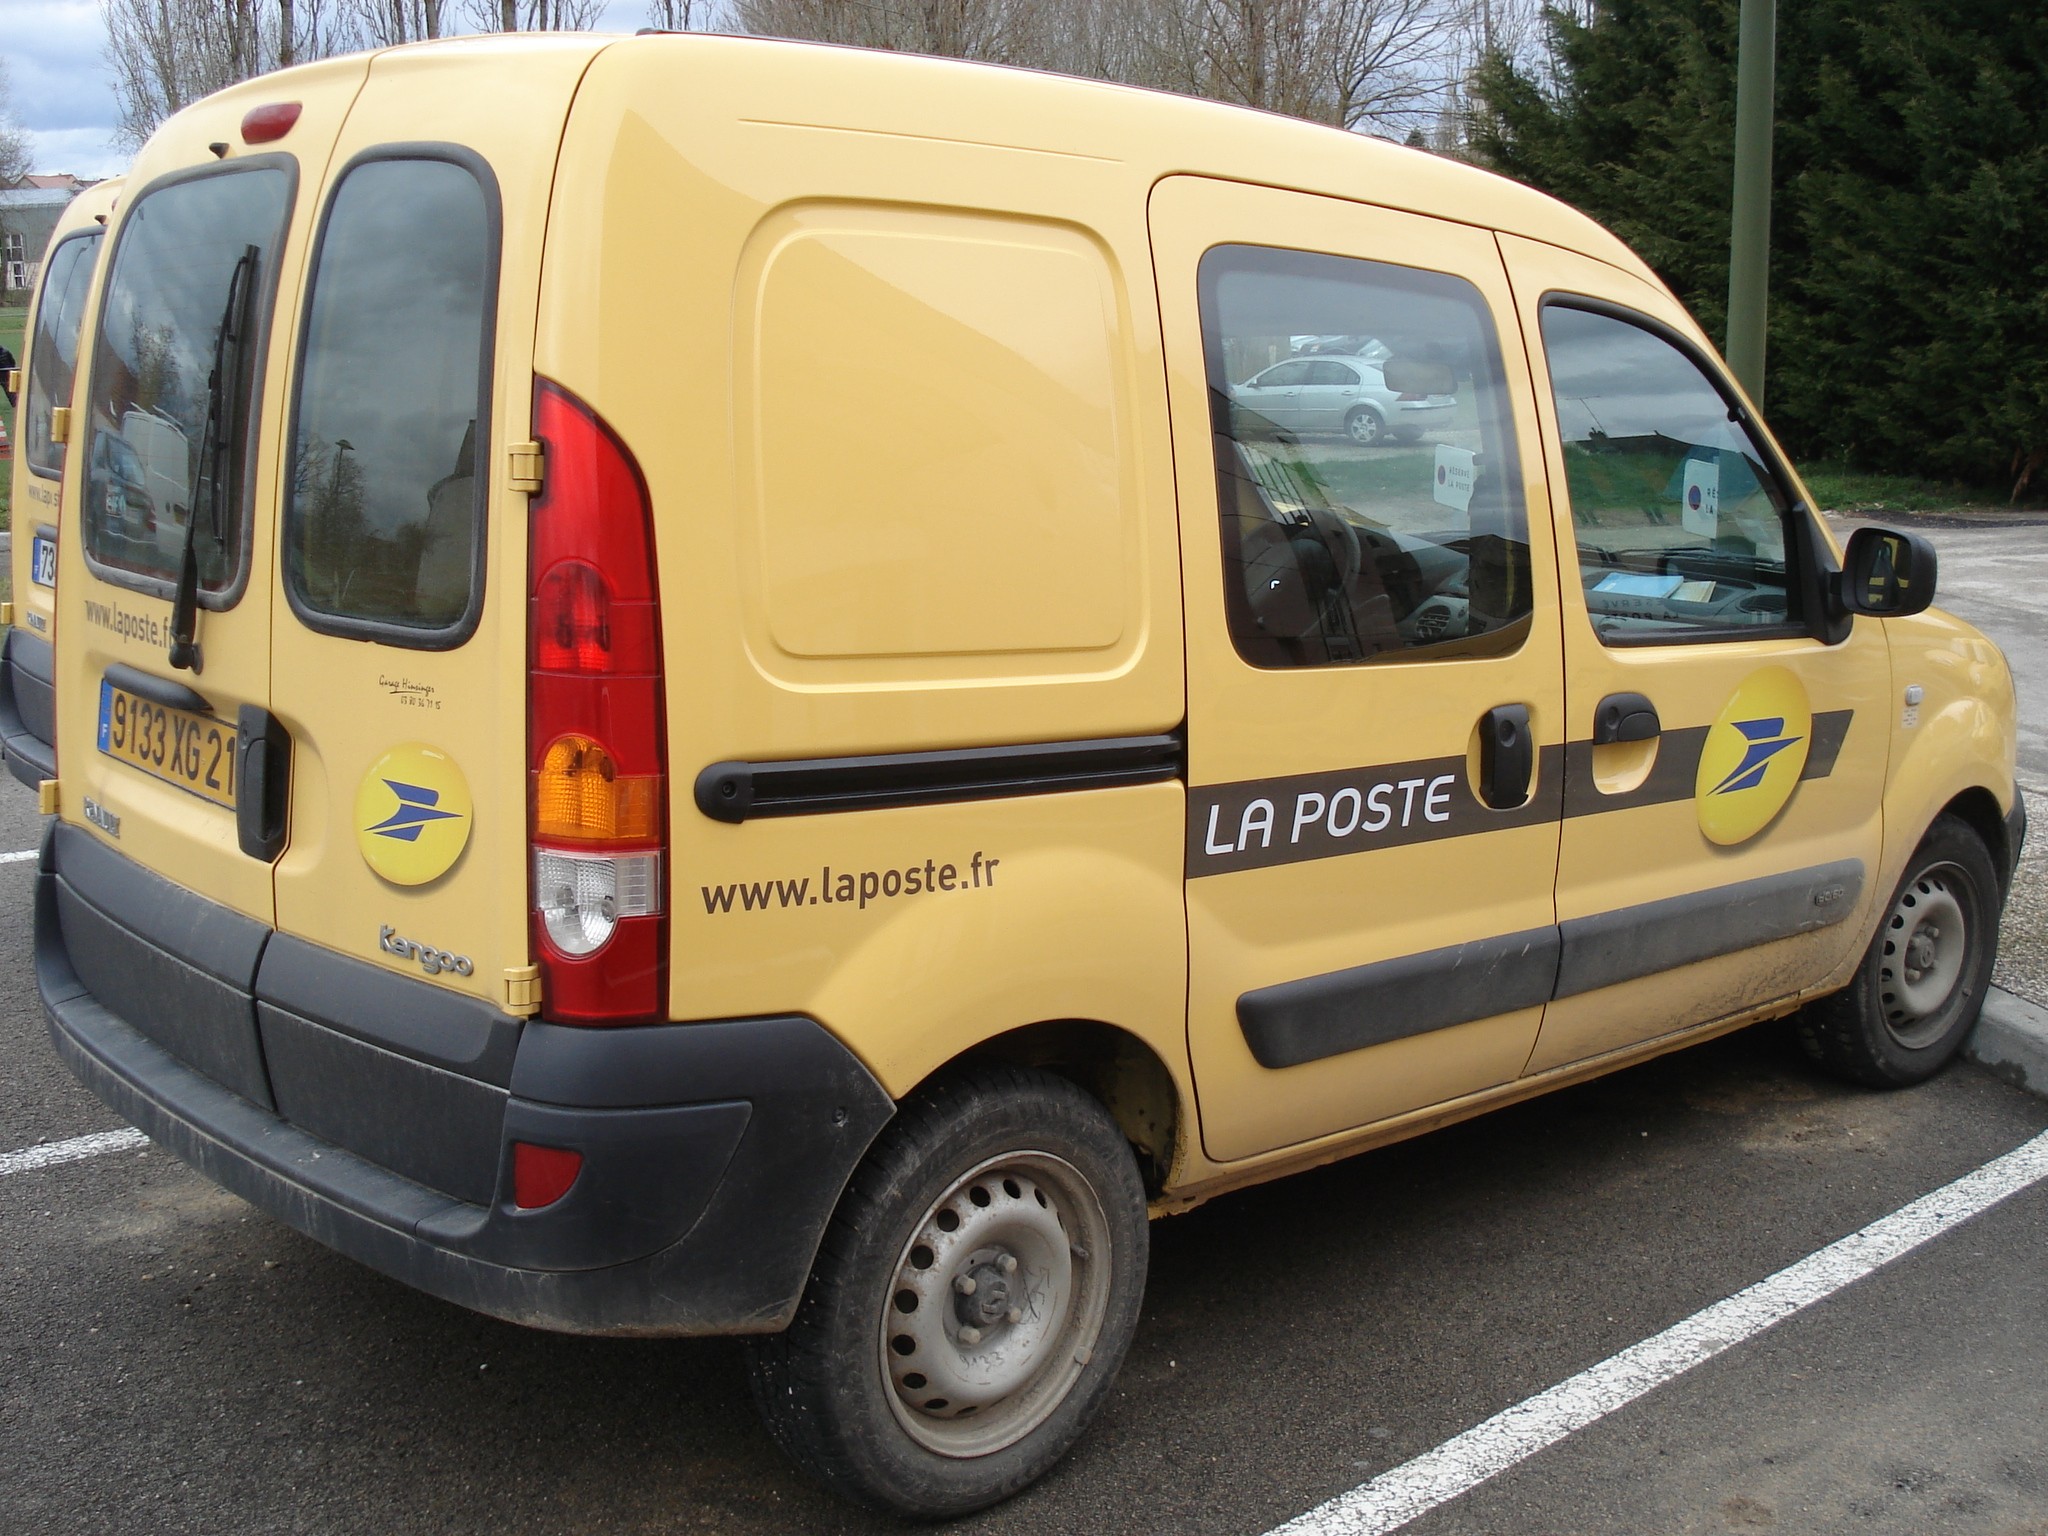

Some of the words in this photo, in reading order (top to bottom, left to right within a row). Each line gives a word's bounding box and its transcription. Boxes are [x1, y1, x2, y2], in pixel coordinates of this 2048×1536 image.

[113, 693, 166, 767] 9133
[170, 714, 201, 781] XG
[205, 728, 236, 796] 21
[1204, 798, 1275, 855] LA
[1290, 774, 1455, 844] POSTE
[701, 851, 1000, 914] www.laposte.fr
